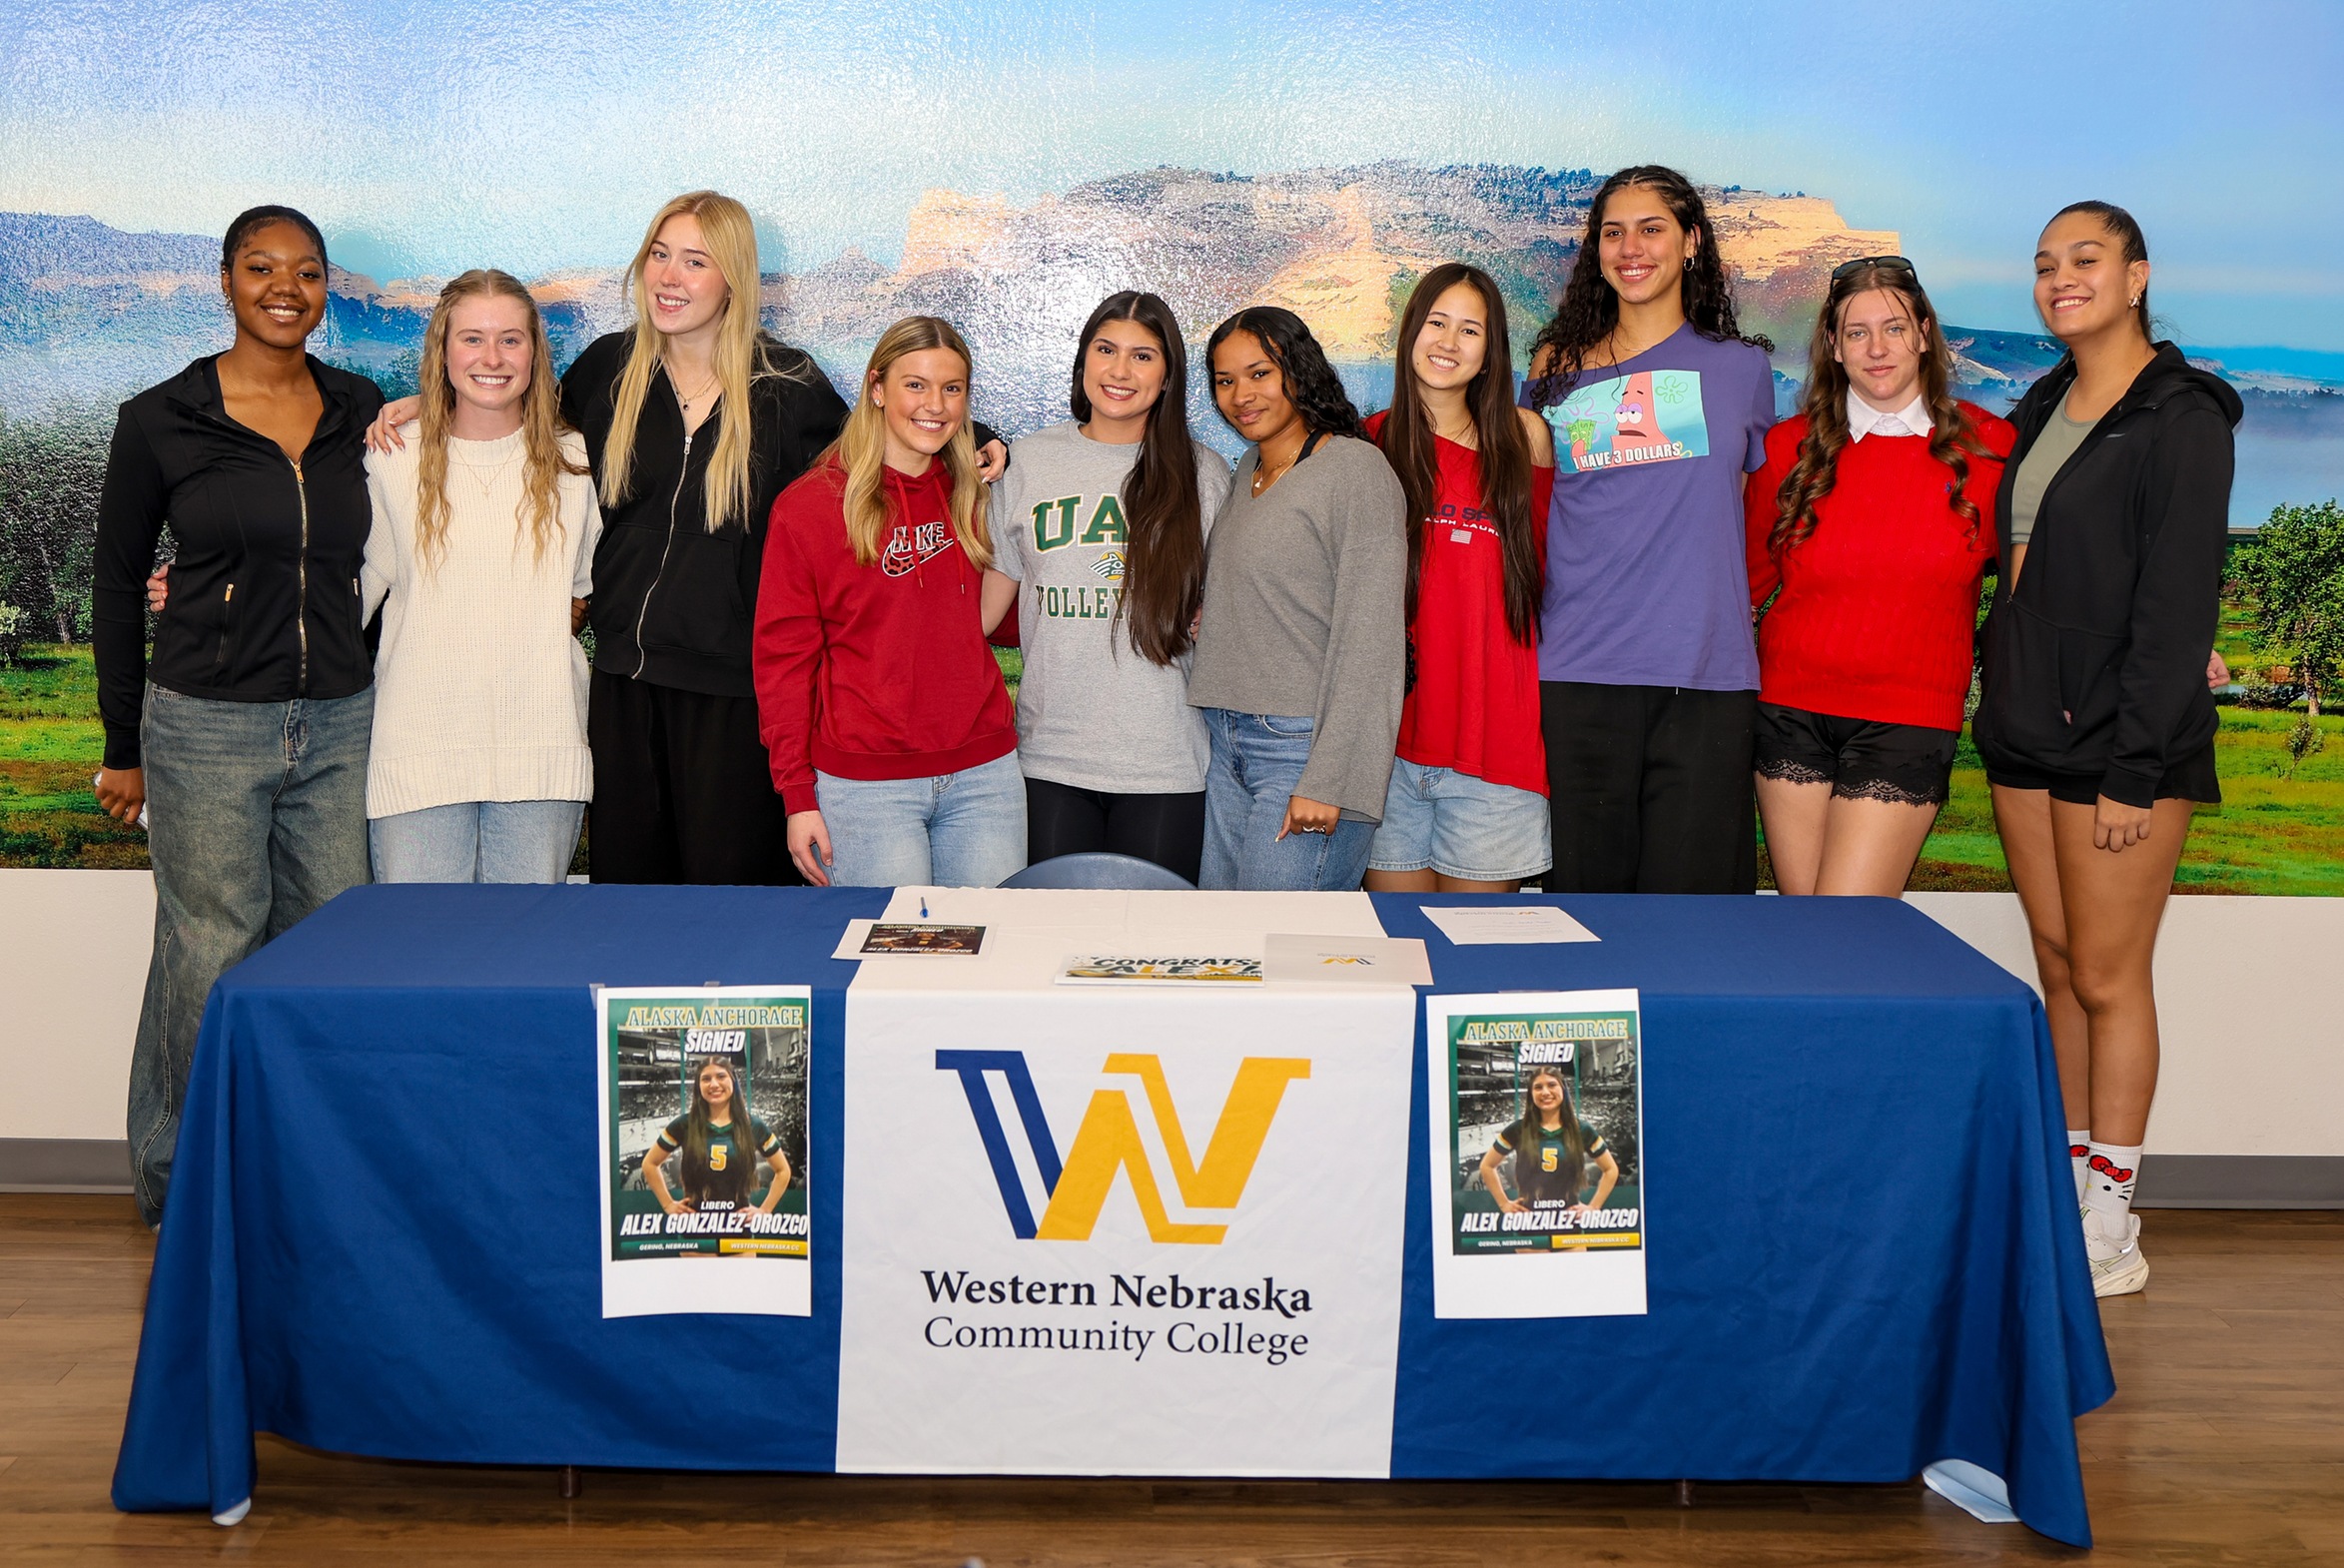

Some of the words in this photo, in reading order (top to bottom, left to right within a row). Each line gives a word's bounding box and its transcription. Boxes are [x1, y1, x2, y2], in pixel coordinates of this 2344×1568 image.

[1573, 457, 1579, 470] I
[1580, 451, 1611, 468] HAVE
[1613, 450, 1623, 463] 3
[1625, 442, 1681, 462] DOLLARS
[893, 522, 945, 553] NKE
[628, 1008, 698, 1027] ALASKA
[700, 1007, 802, 1027] ANCHORAGE
[684, 1031, 746, 1053] SIGNED
[1466, 1022, 1530, 1041] ALASKA
[1533, 1021, 1628, 1040] ANCHORAGE
[1518, 1043, 1575, 1064] SIGNED
[710, 1145, 727, 1171] 5
[1542, 1148, 1557, 1172] 5
[700, 1200, 735, 1210] LIBERO
[1533, 1199, 1565, 1208] LIBERO
[620, 1212, 663, 1235] ALEX
[665, 1211, 808, 1235] GONZALEZ-OROZCO
[1460, 1211, 1500, 1232] ALEX
[1502, 1207, 1639, 1230] GONZALEZ-OROZCO
[920, 1270, 1098, 1306] Western
[1110, 1273, 1313, 1318] Nebraska
[924, 1315, 1156, 1362] Community
[1167, 1321, 1309, 1365] College
